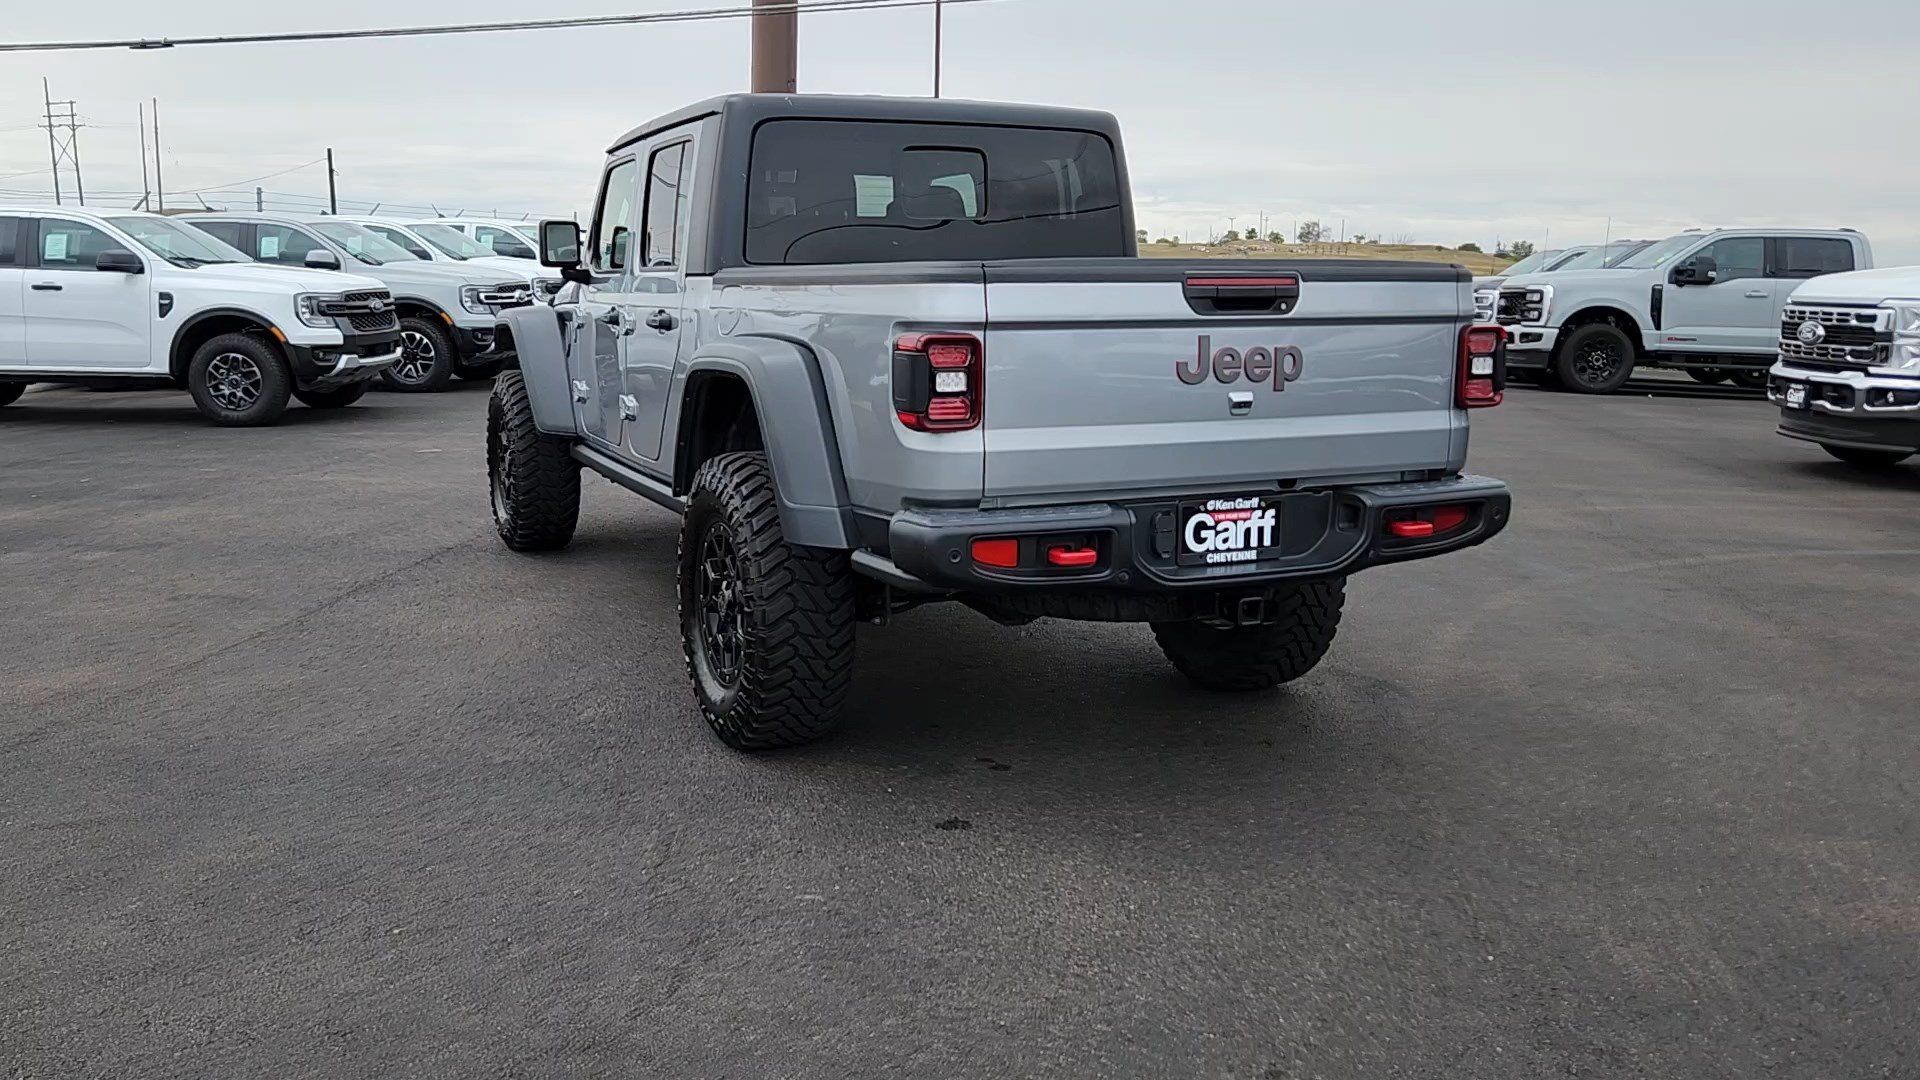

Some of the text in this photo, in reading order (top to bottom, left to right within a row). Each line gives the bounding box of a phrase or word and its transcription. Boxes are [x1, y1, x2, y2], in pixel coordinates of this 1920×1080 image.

[1176, 335, 1303, 392] Jeep
[1215, 497, 1260, 510] Ken Garff
[1185, 509, 1276, 553] Garff
[1206, 550, 1258, 563] CHEYENNE
